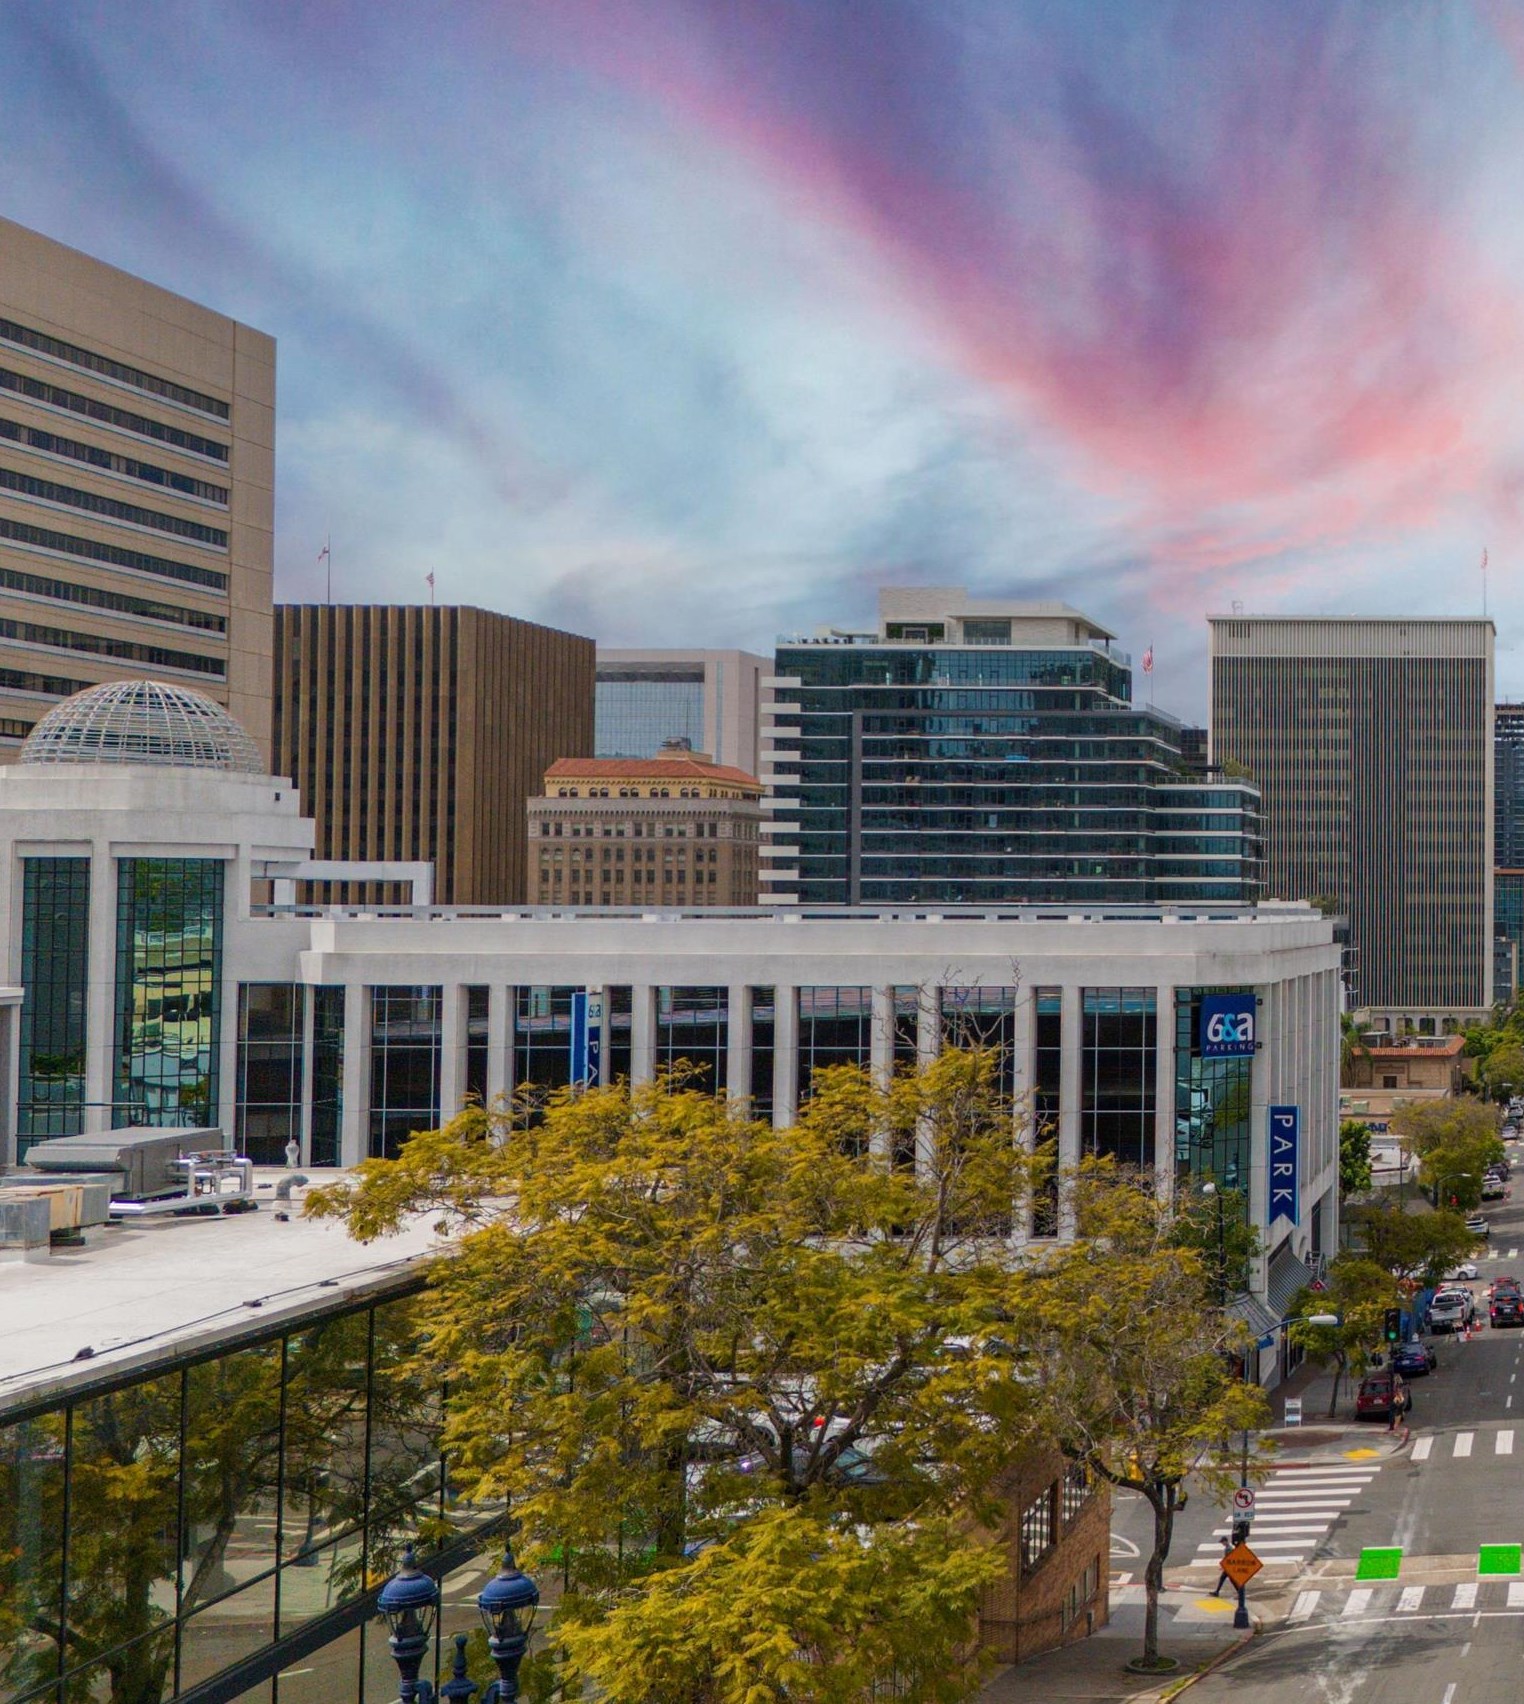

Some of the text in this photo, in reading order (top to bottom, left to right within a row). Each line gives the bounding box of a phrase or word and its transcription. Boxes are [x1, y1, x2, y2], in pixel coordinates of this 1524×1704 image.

[1207, 1012, 1253, 1042] 6&a
[1206, 1042, 1254, 1052] PARKING
[1273, 1114, 1294, 1203] PARK
